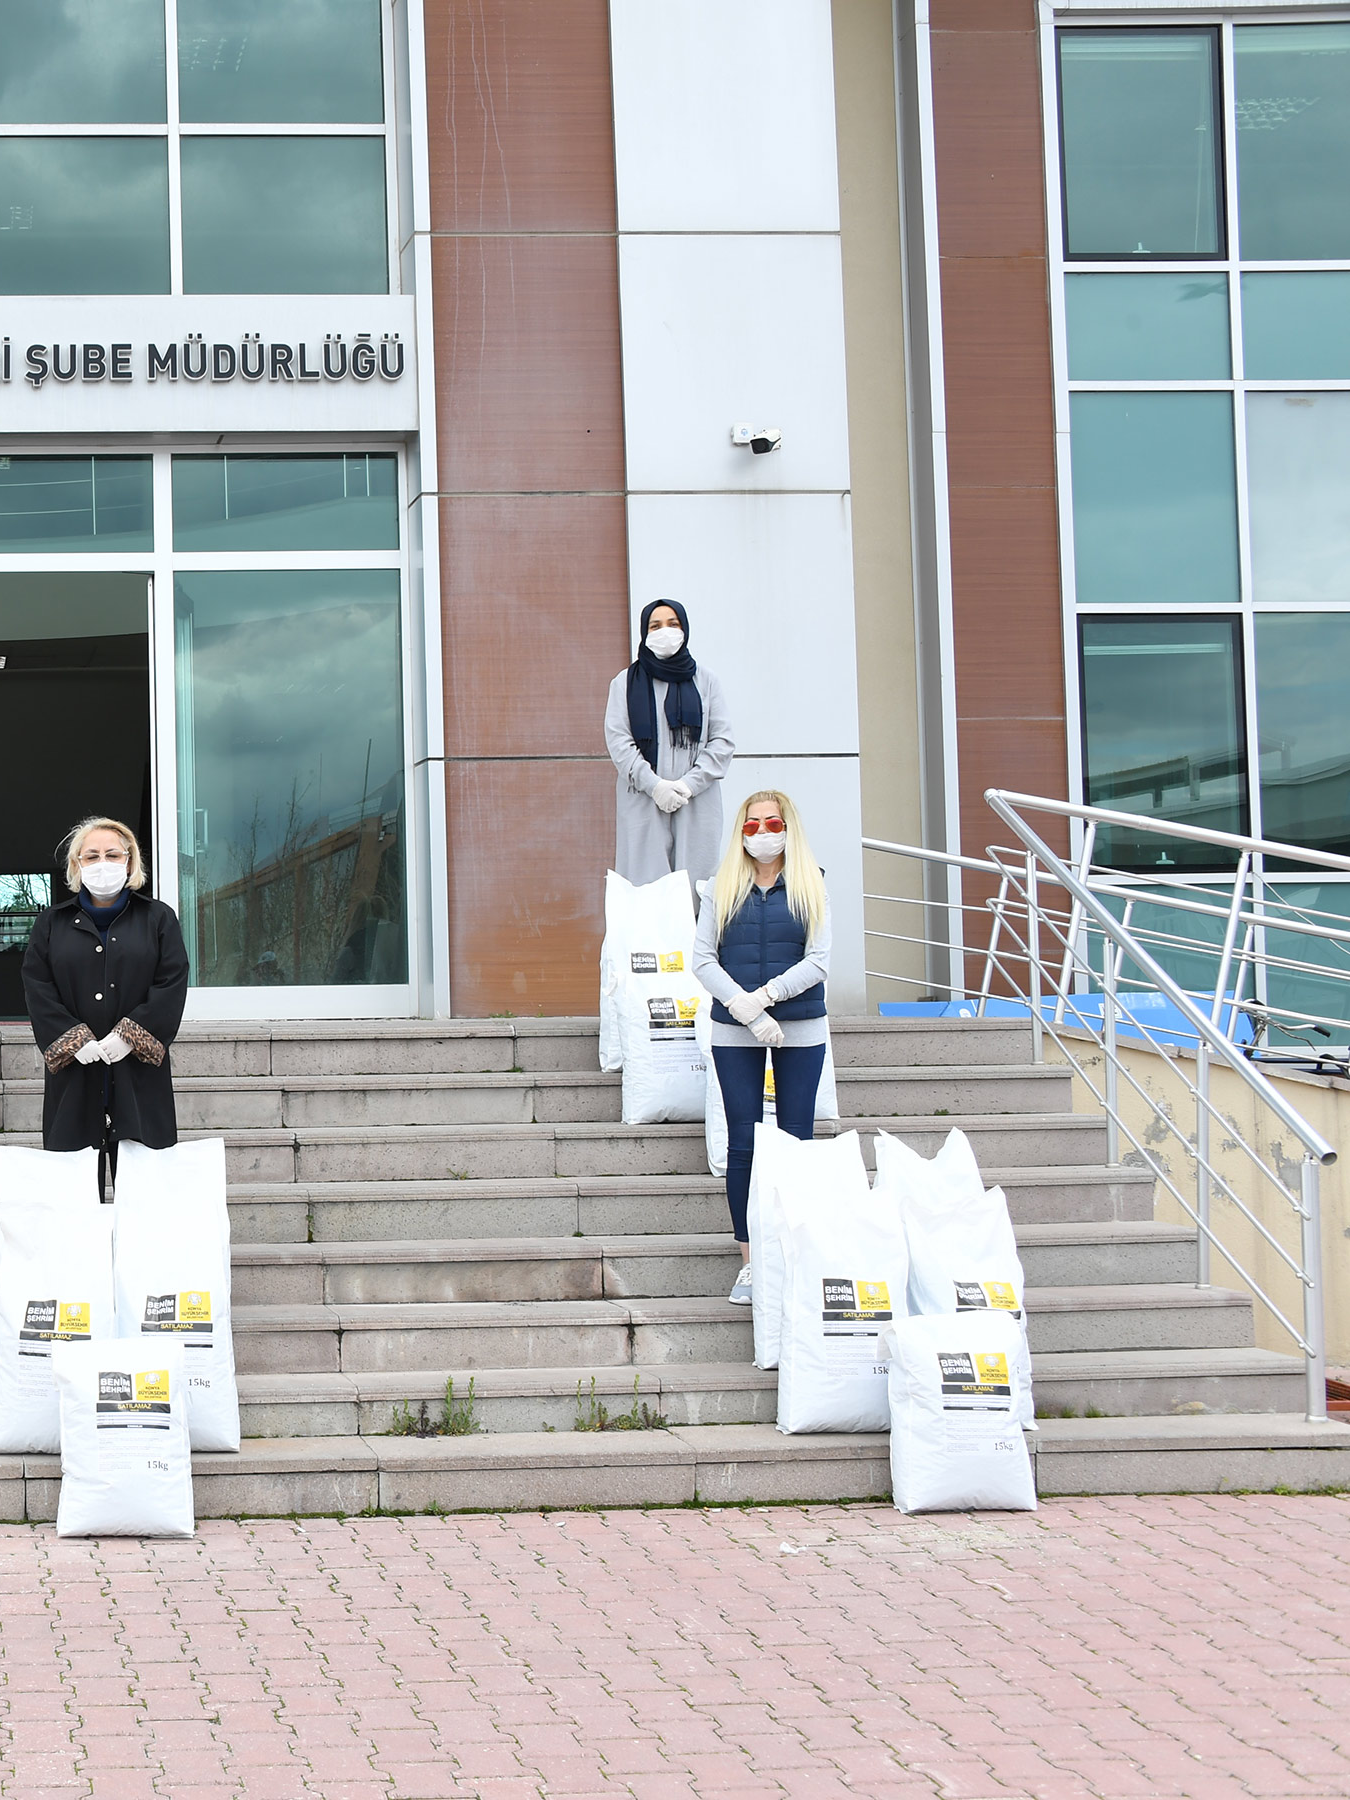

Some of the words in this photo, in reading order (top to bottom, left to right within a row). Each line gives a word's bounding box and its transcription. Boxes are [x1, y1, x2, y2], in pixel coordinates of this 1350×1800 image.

[24, 342, 134, 388] ŞUBE
[146, 332, 406, 384] MÜDÜRLÜĞÜ
[825, 1285, 853, 1294] BENİM
[826, 1294, 854, 1302] ŞEHRİM
[147, 1299, 174, 1309] BENİM
[28, 1306, 55, 1314] BENİM
[26, 1315, 54, 1323] ŞEHRİM
[941, 1357, 971, 1367] BENİM
[100, 1377, 130, 1386] BENİM
[189, 1378, 210, 1388] 15kg
[995, 1442, 1013, 1452] 15kg
[147, 1461, 168, 1471] 15kg
